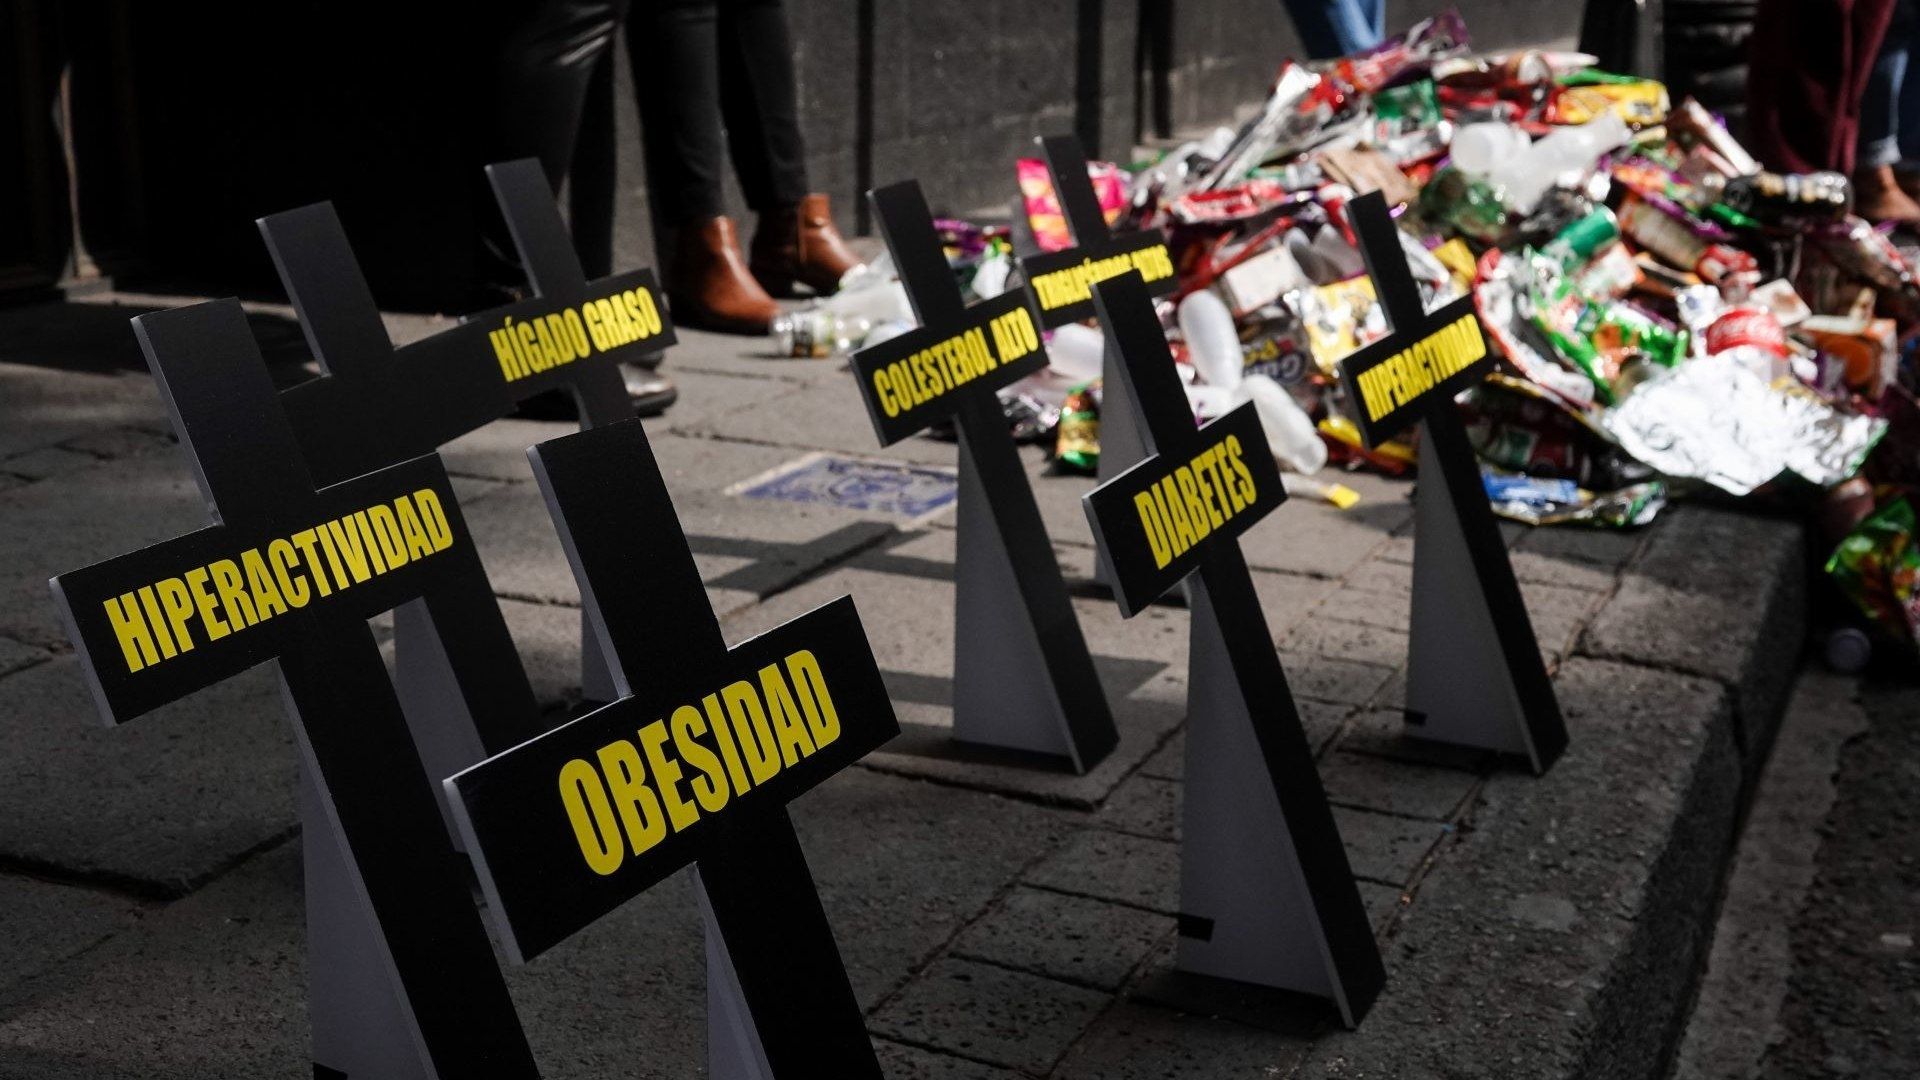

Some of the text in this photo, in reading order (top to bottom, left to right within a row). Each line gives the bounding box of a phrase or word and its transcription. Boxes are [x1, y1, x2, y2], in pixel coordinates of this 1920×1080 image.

[488, 285, 663, 383] HÍGADO GRASO
[873, 306, 1039, 419] COLESTEROL ALTO
[1356, 313, 1487, 422] HIPERACTIVIDAD
[1133, 434, 1257, 570] DIABETES
[103, 488, 454, 673] HIPERACTIVIDAD
[557, 649, 842, 876] OBESIDAD
